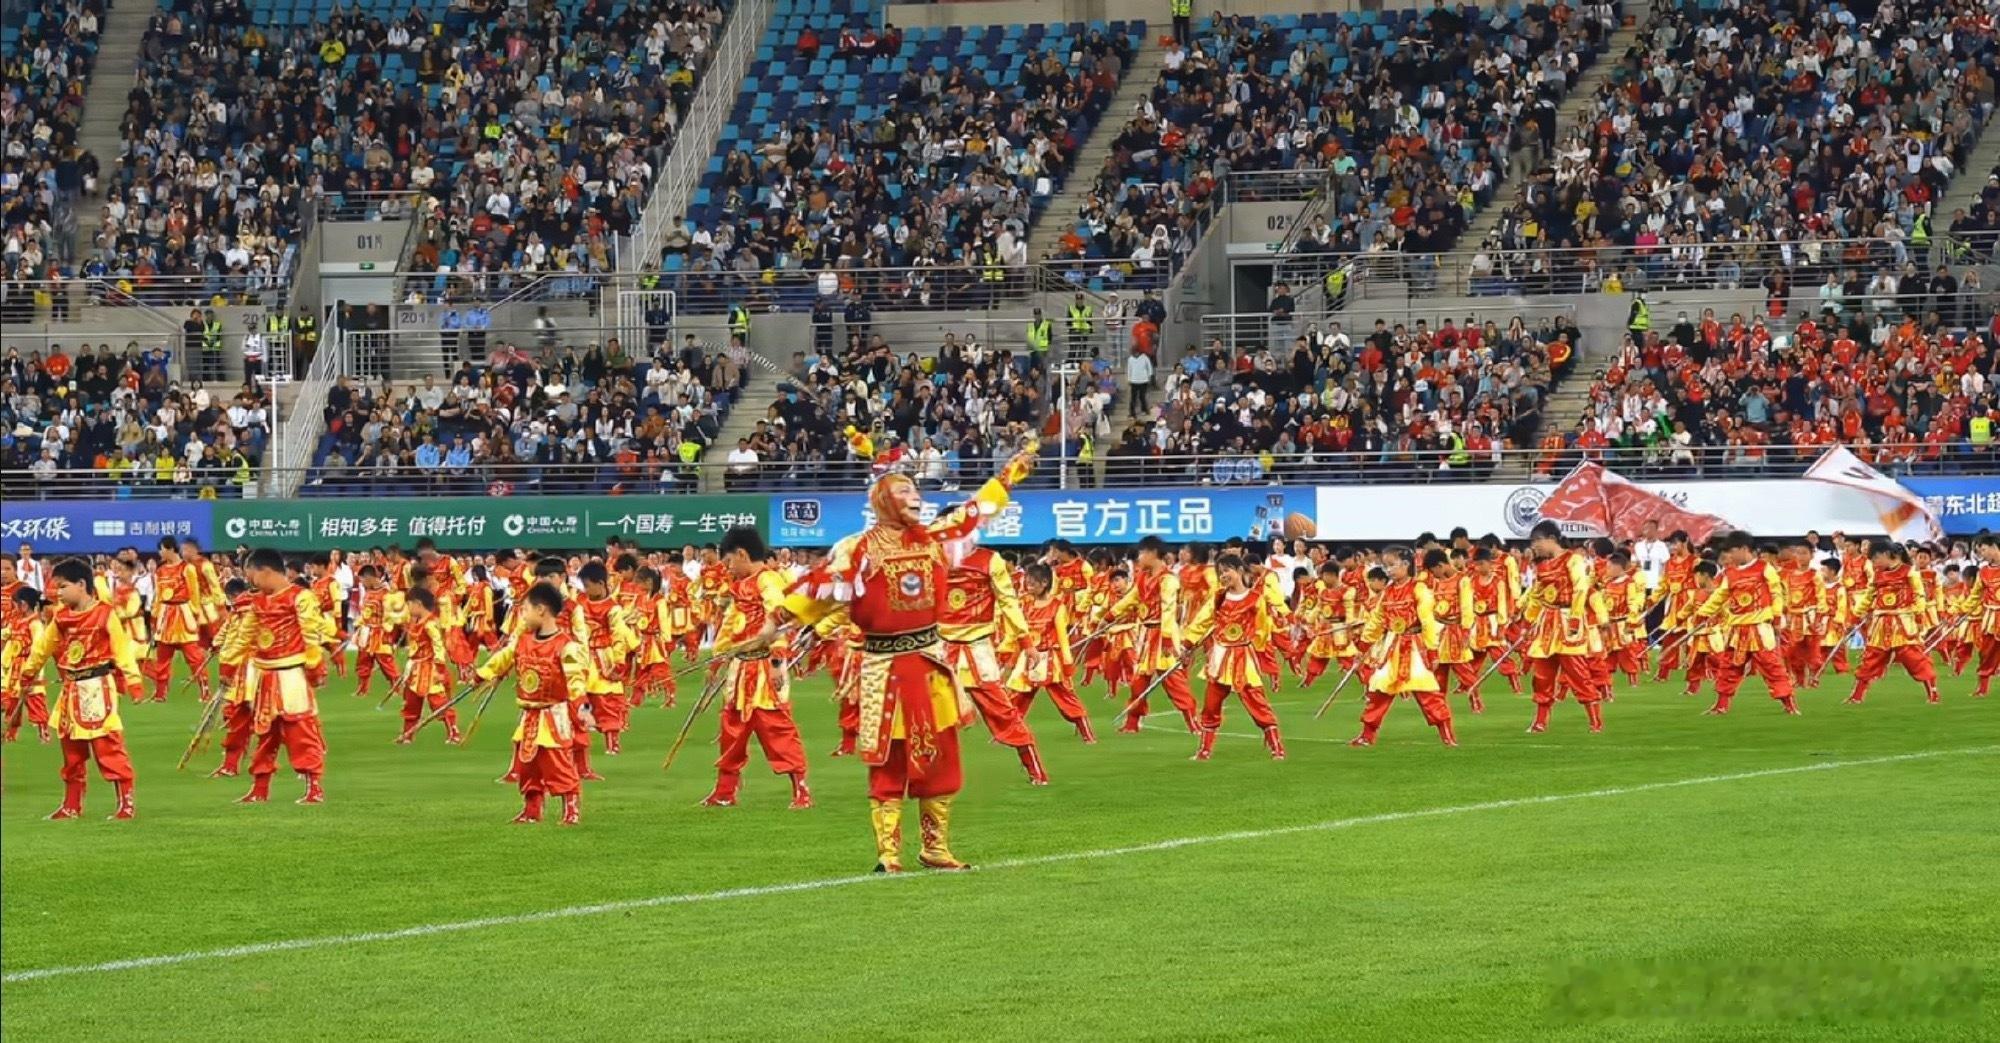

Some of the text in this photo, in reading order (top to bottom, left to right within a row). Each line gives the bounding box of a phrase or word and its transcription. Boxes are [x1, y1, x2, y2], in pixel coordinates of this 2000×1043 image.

[320, 515, 486, 537] 相知多年 值得托付
[597, 514, 675, 534] 一个国寿
[679, 513, 757, 533] 一生守护
[1051, 498, 1213, 537] 官方正品
